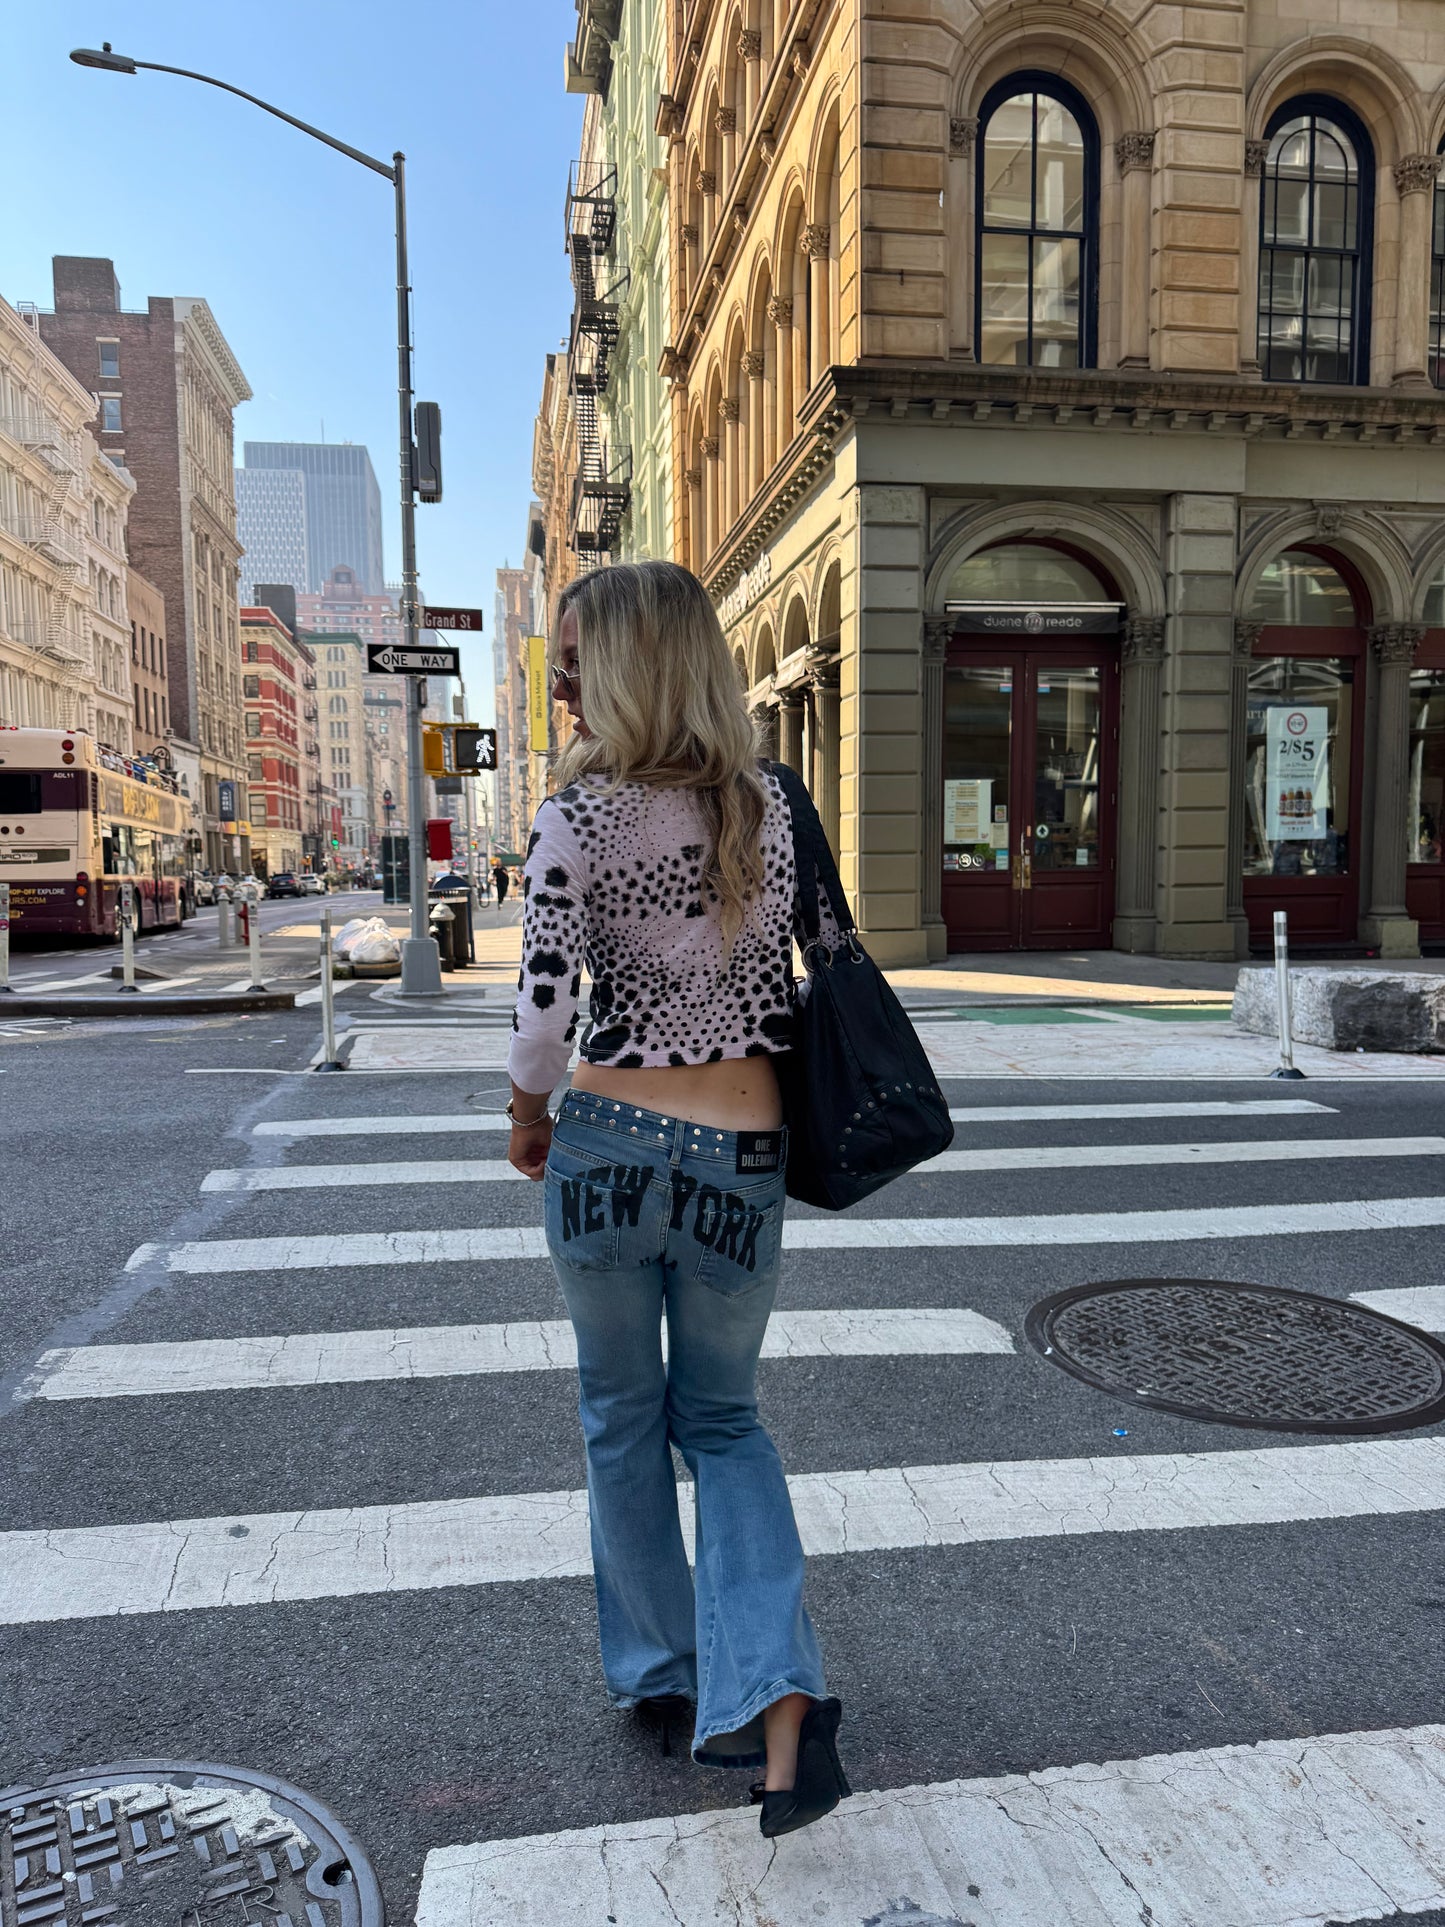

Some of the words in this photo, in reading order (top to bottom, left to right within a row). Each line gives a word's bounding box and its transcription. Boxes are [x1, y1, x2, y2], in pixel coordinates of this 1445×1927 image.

[425, 612, 456, 628] Grand
[460, 614, 471, 629] St
[983, 615, 1022, 627] duane
[1046, 615, 1083, 628] reade
[382, 653, 408, 666] ONE
[420, 655, 448, 667] WAY
[1280, 738, 1314, 761] 2/$5
[37, 888, 66, 896] EXPLORE
[755, 1139, 771, 1152] ONE
[561, 1165, 655, 1243] NEW
[668, 1168, 765, 1273] YORK
